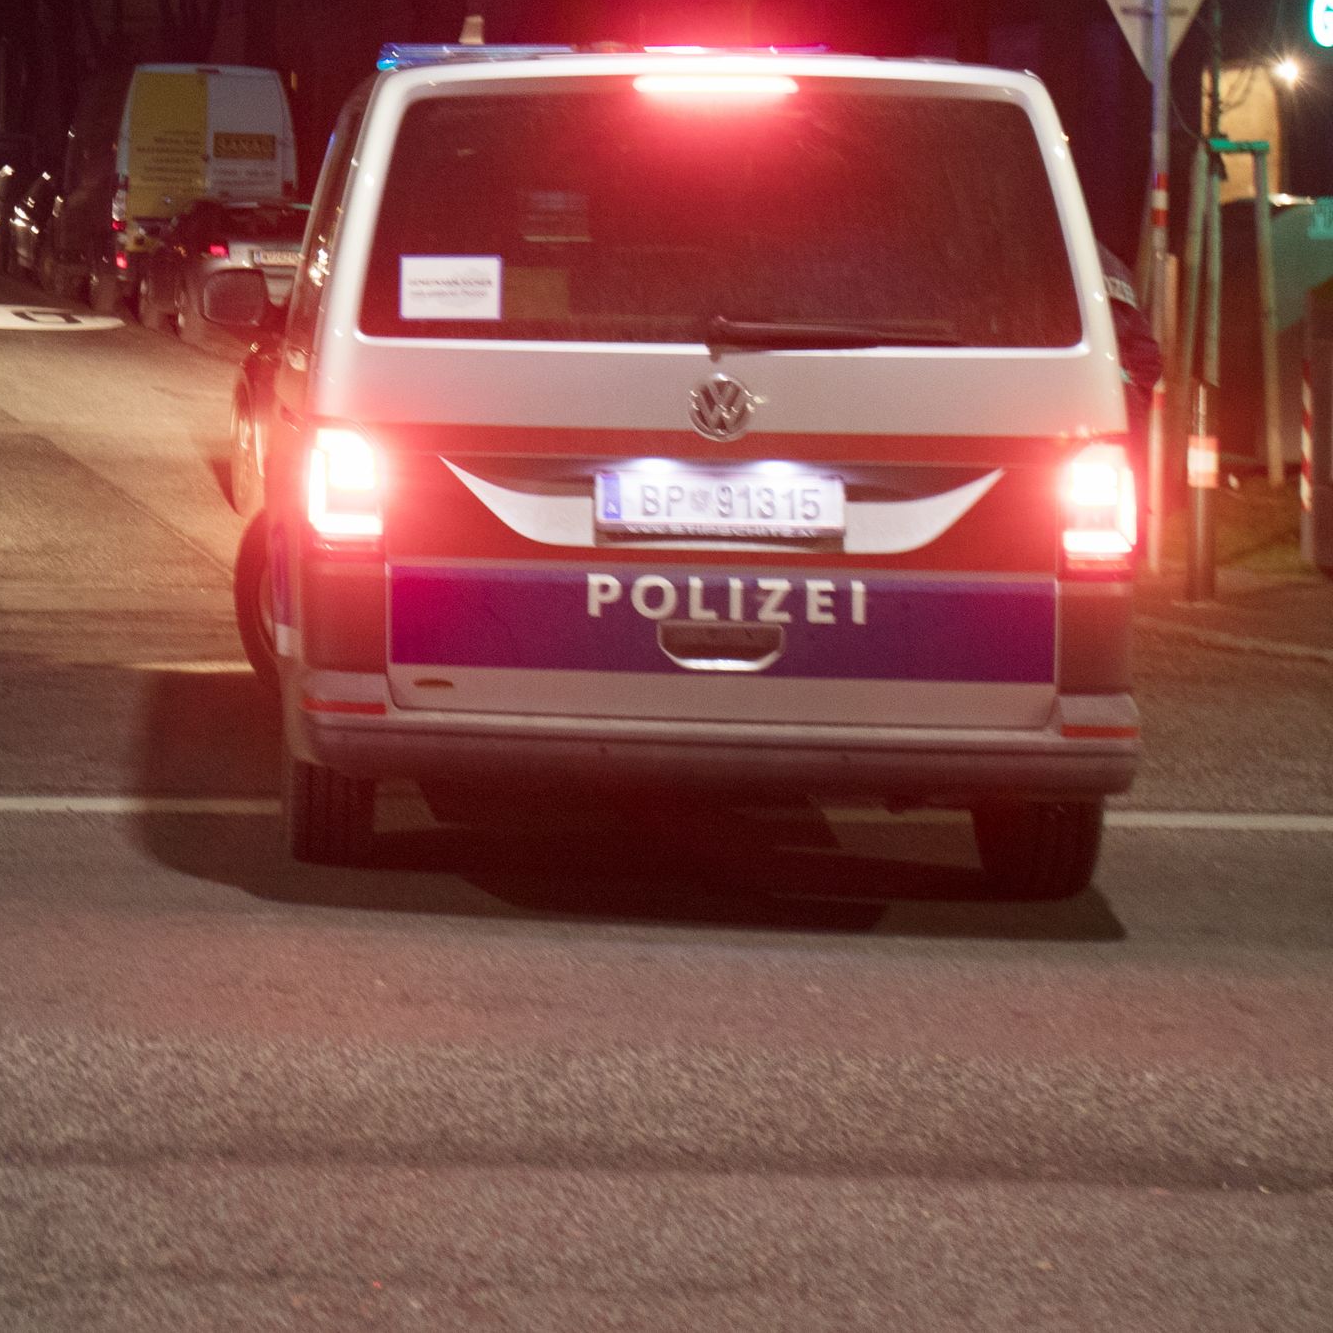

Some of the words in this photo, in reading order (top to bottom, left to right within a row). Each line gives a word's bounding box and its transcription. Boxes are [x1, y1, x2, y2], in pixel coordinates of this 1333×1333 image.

[640, 484, 685, 518] BP
[716, 484, 821, 522] 91315
[586, 573, 868, 626] POLIZEI
